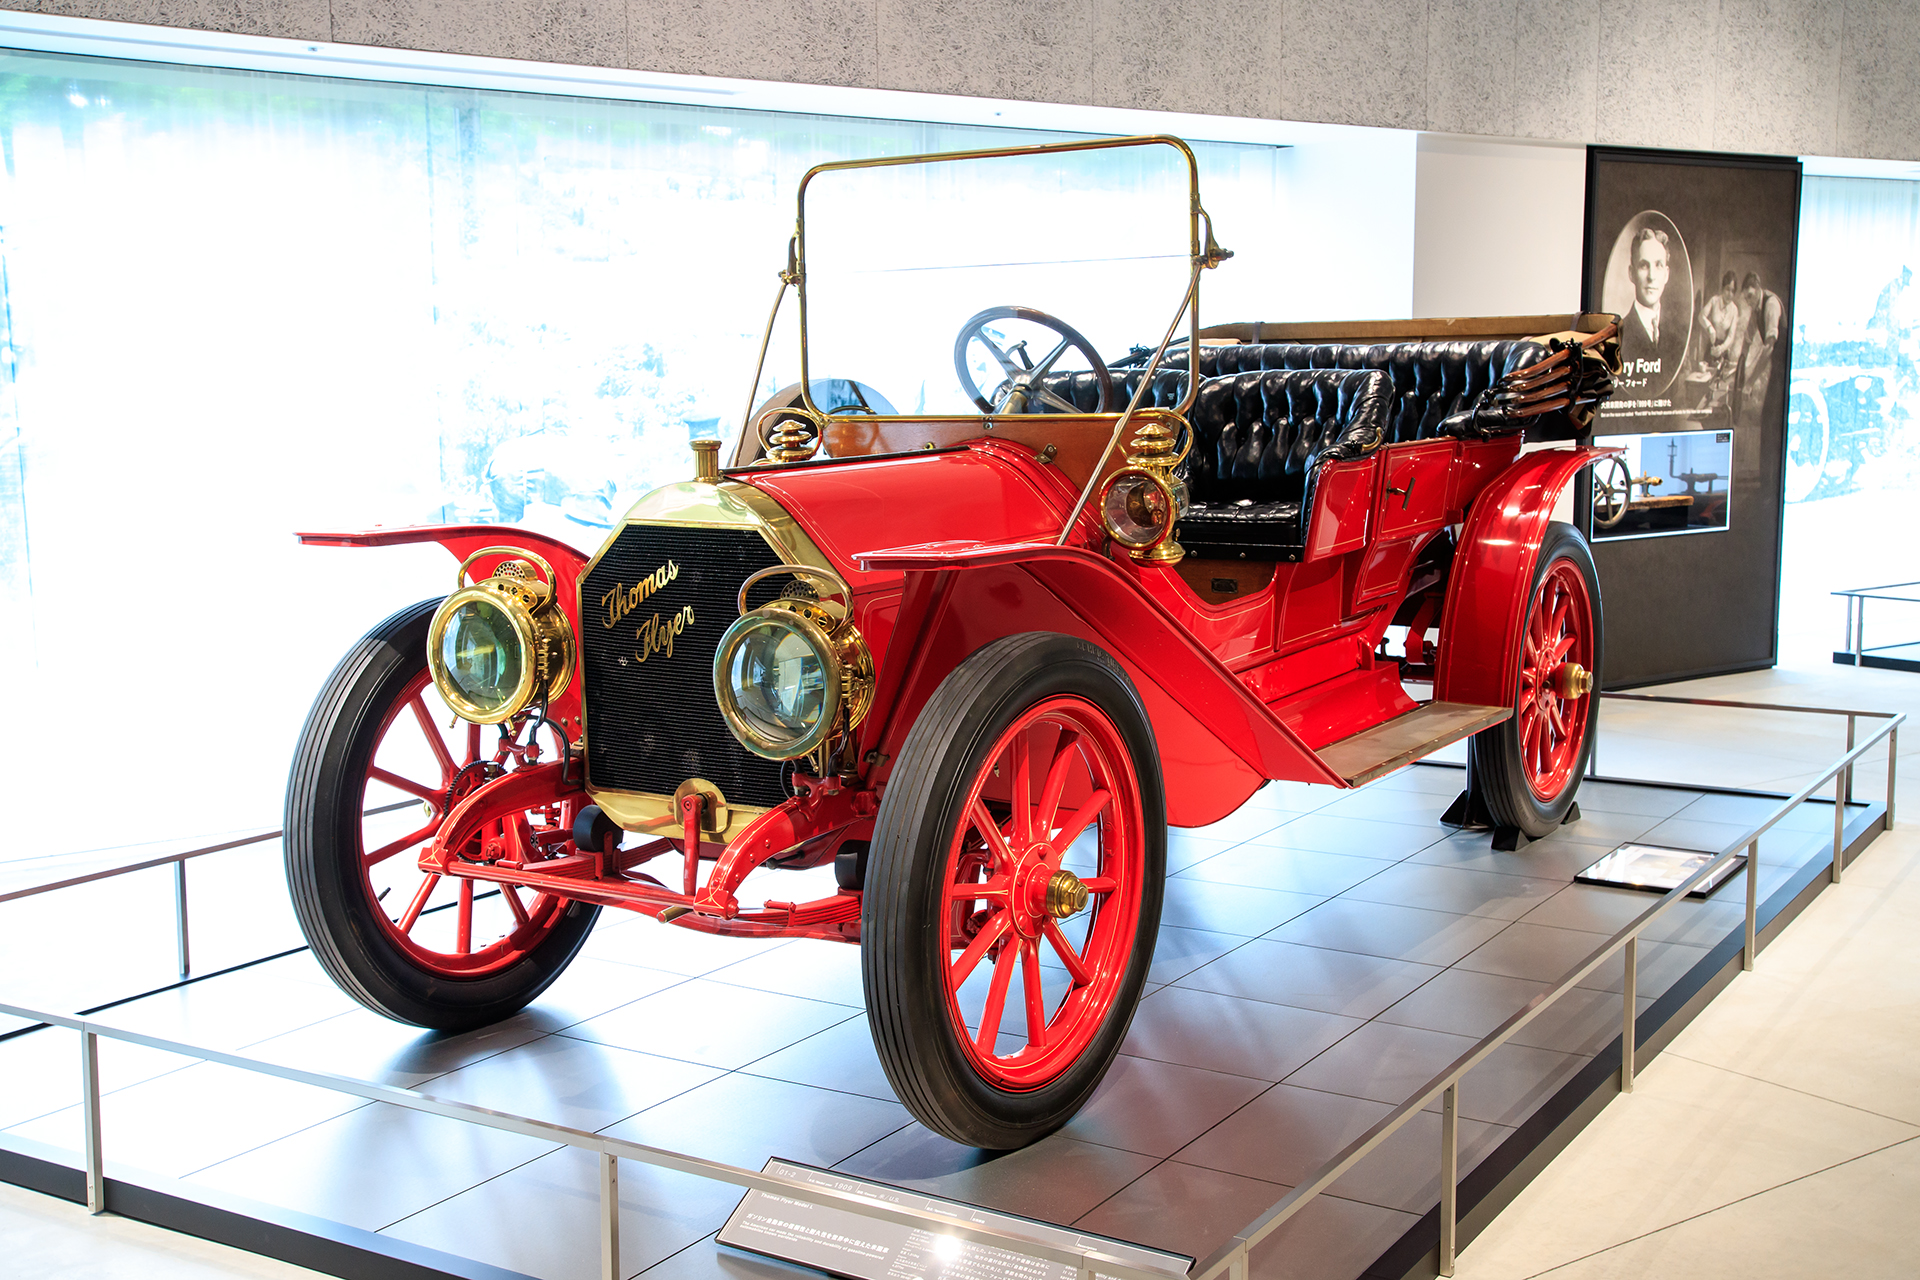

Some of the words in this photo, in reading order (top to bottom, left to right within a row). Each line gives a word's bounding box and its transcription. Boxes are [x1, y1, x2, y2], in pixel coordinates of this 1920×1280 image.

[1636, 358, 1661, 374] Ford
[601, 559, 679, 629] Thomas
[635, 605, 694, 663] Flyer
[779, 1169, 796, 1178] 01-2
[834, 1182, 853, 1191] 1909
[760, 1192, 779, 1201] Thomas
[779, 1197, 793, 1205] Flyer
[793, 1200, 809, 1208] Model
